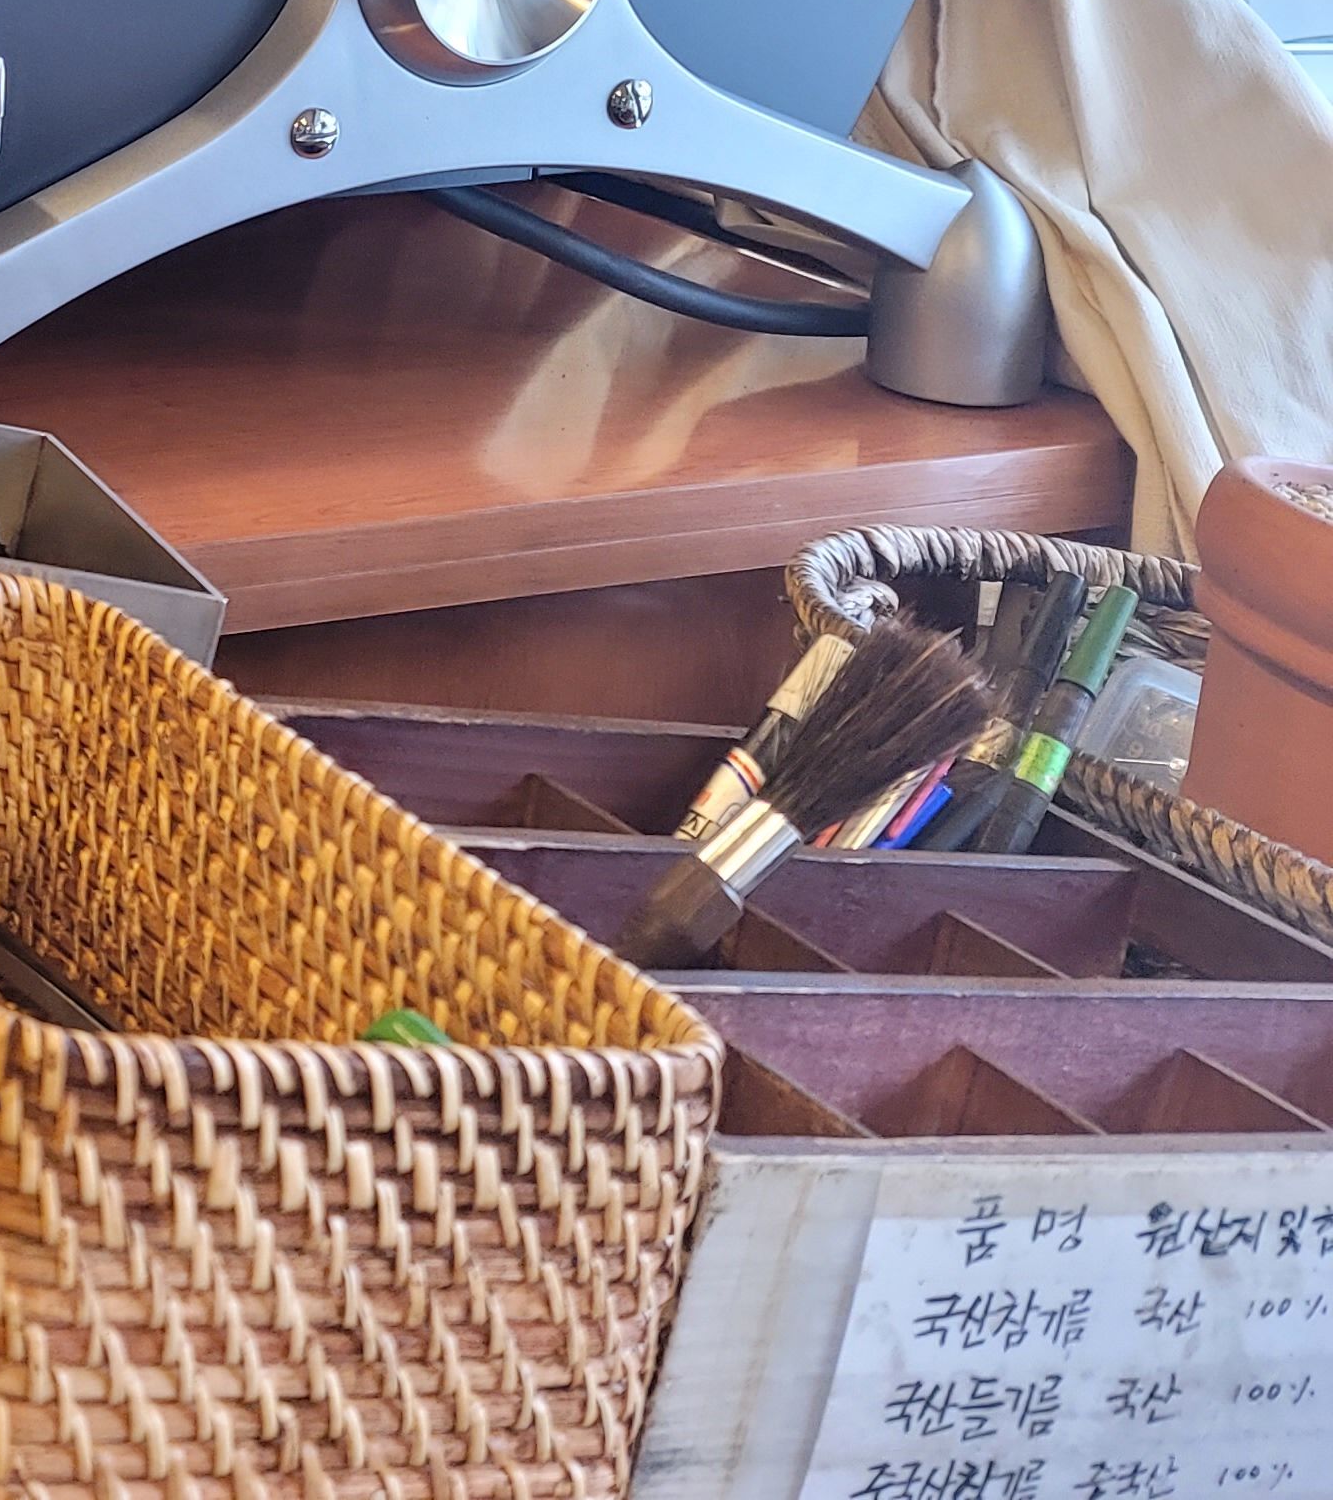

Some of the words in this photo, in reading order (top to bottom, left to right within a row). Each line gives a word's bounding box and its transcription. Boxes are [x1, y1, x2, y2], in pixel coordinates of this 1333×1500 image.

[912, 1288, 1093, 1353] 국산참기름
[1134, 1286, 1206, 1336] 국산
[884, 1374, 1063, 1443] 국산들기름
[1105, 1372, 1182, 1425] 국산
